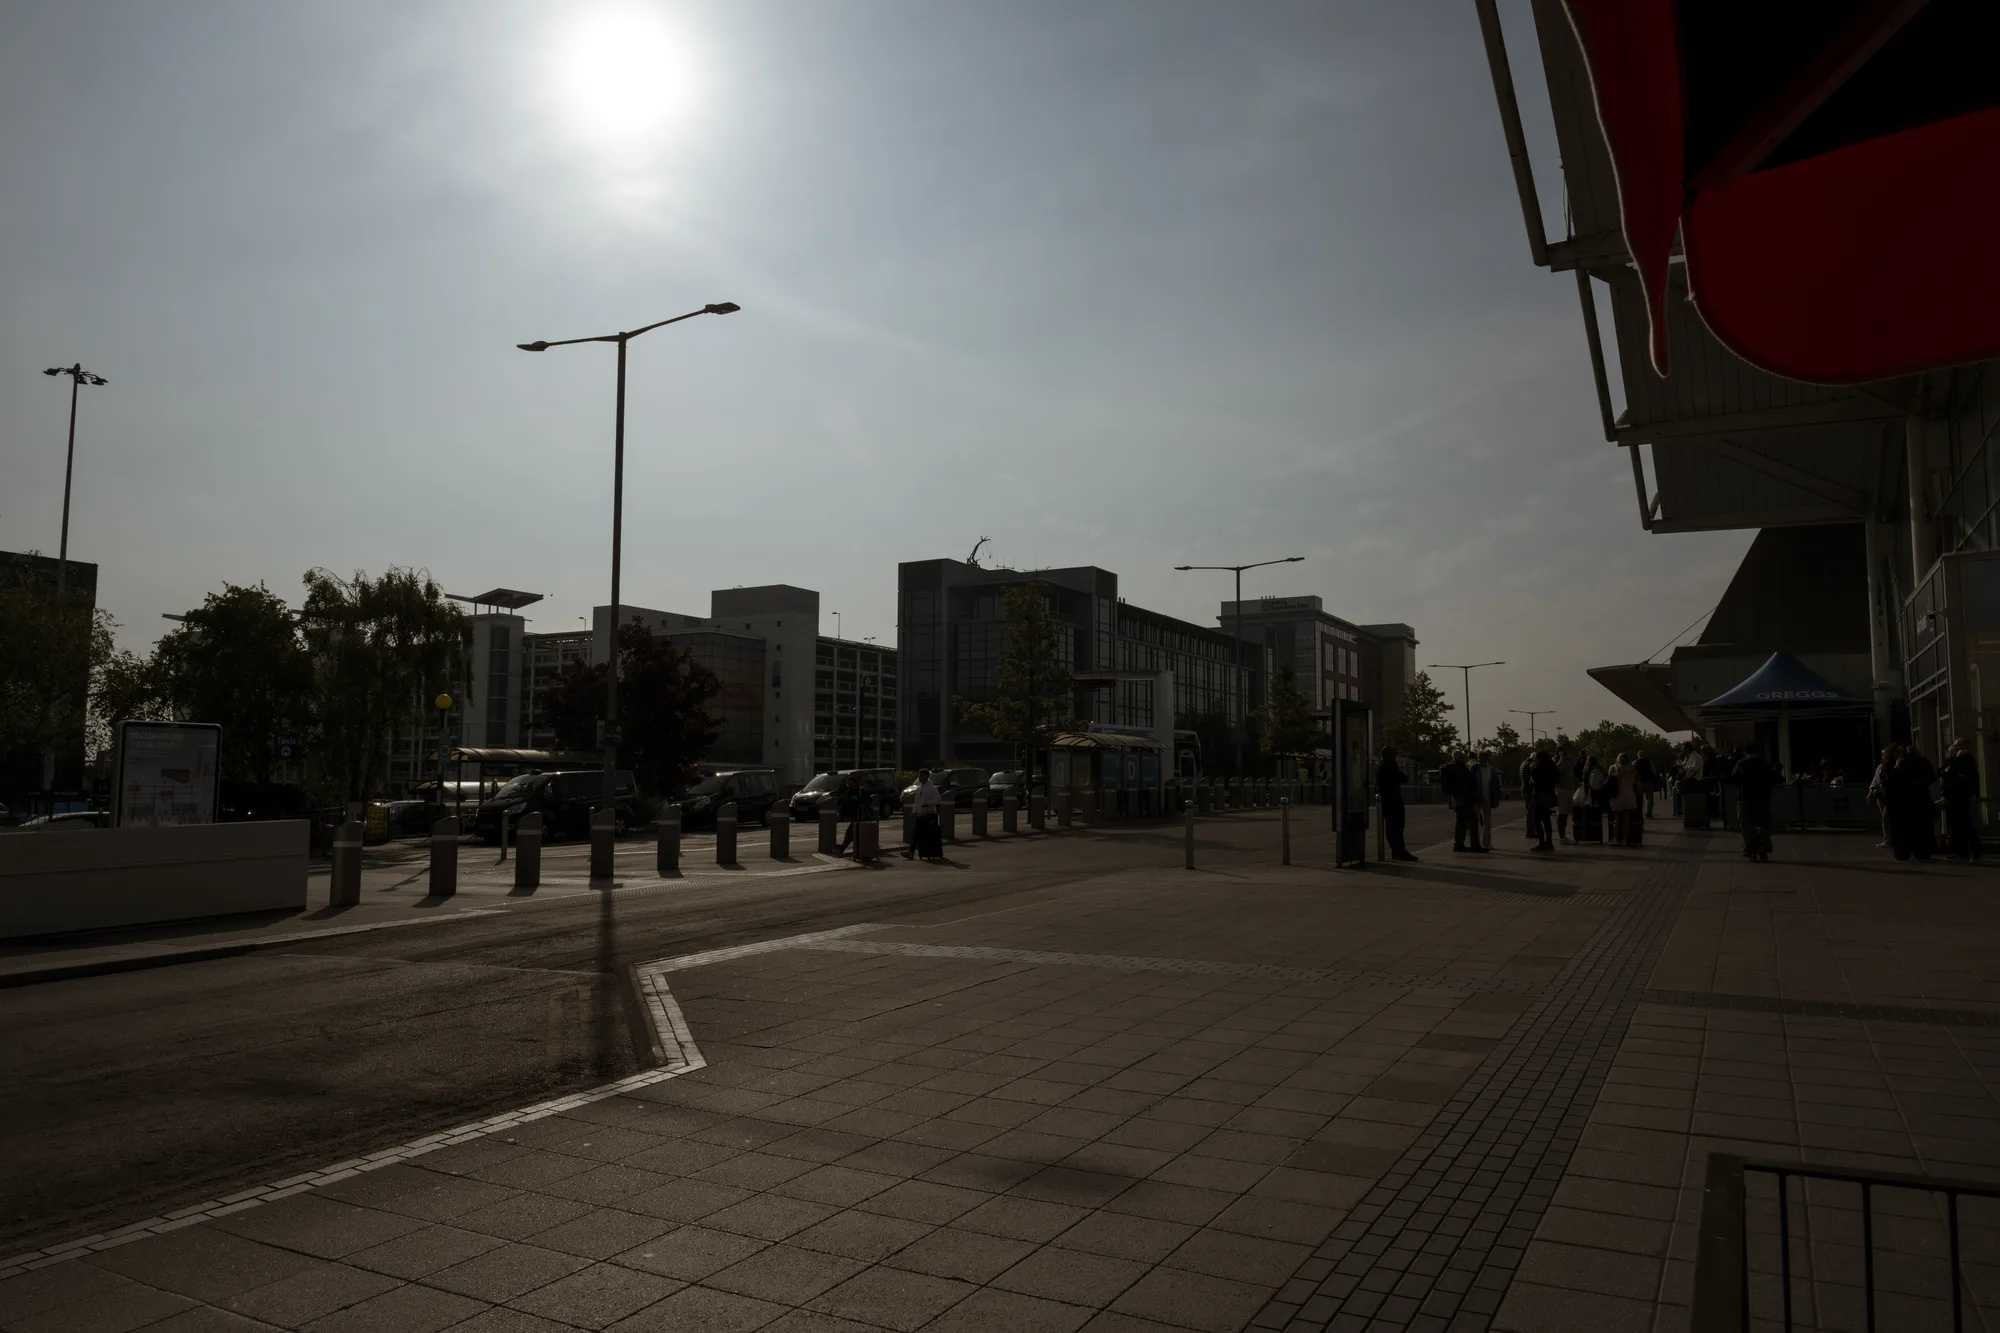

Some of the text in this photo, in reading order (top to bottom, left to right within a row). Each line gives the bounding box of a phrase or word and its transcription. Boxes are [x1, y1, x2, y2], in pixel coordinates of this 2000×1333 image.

[1756, 690, 1837, 700] GREGGS
[276, 736, 296, 745] Taxis
[1127, 760, 1136, 780] D
